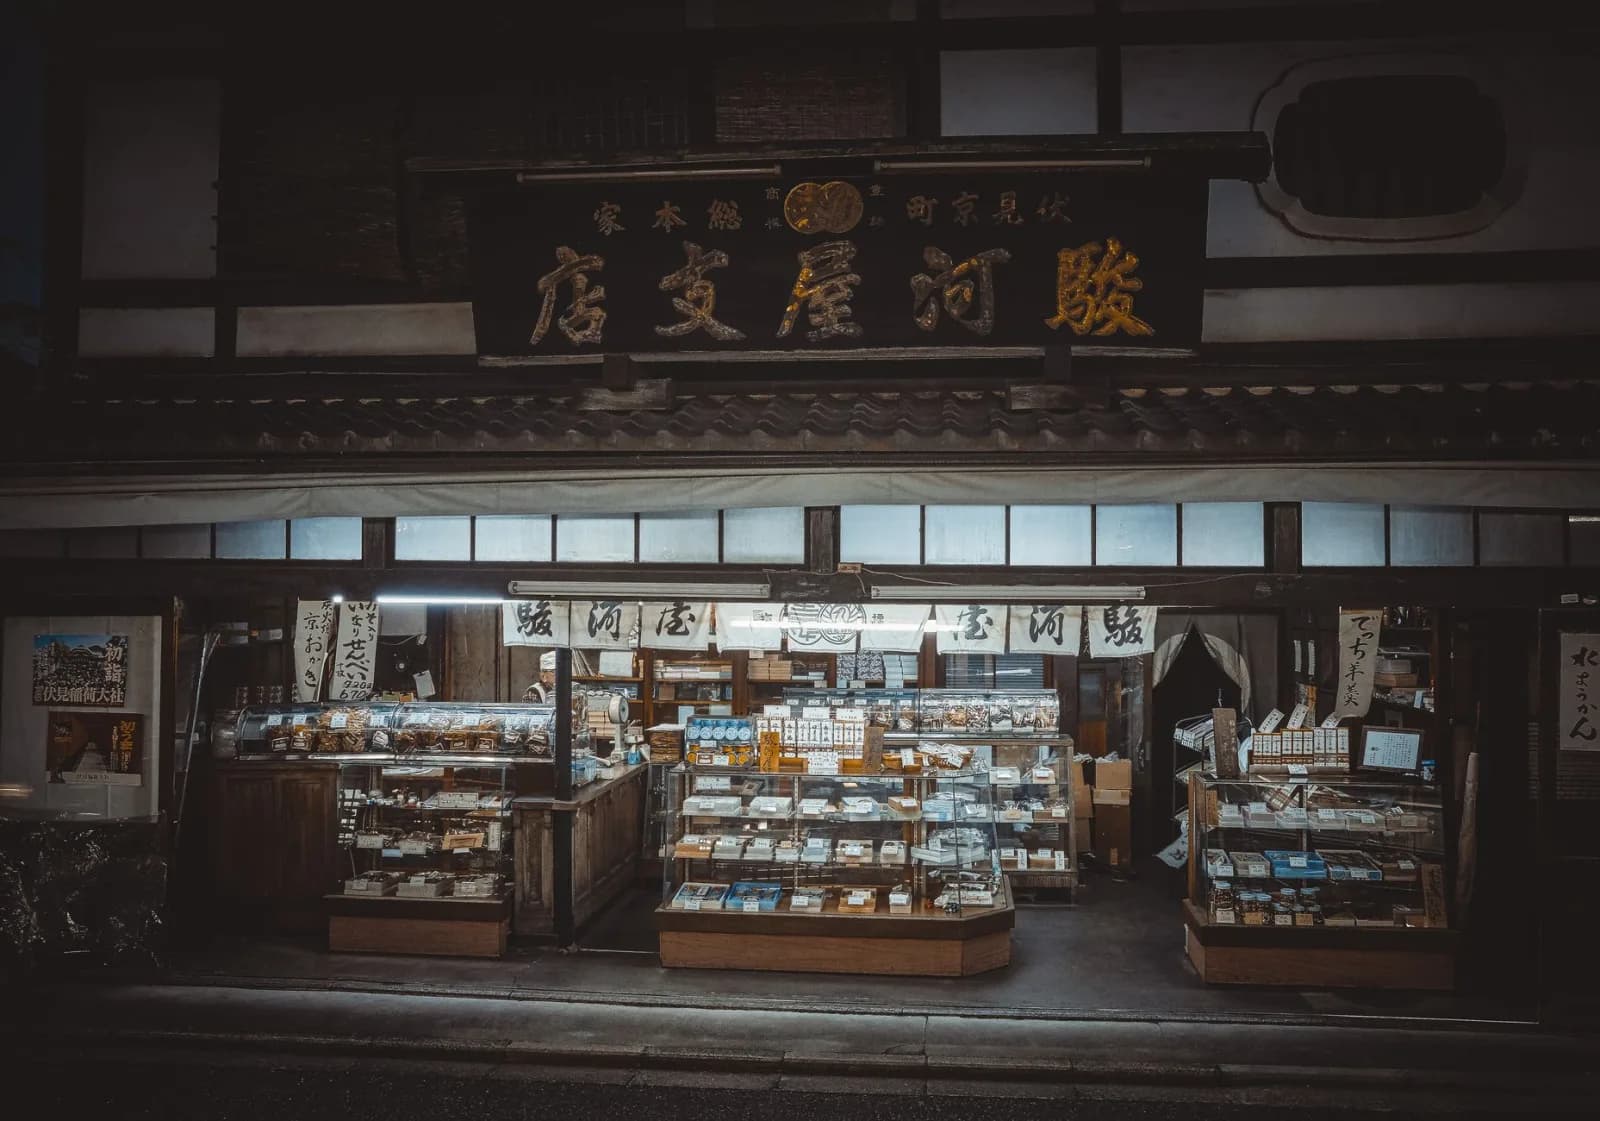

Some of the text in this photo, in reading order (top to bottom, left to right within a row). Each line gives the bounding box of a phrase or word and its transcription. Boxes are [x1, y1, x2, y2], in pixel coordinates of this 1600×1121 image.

[303, 612, 322, 688] 京おかき
[43, 685, 124, 703] 伏見稲荷大社
